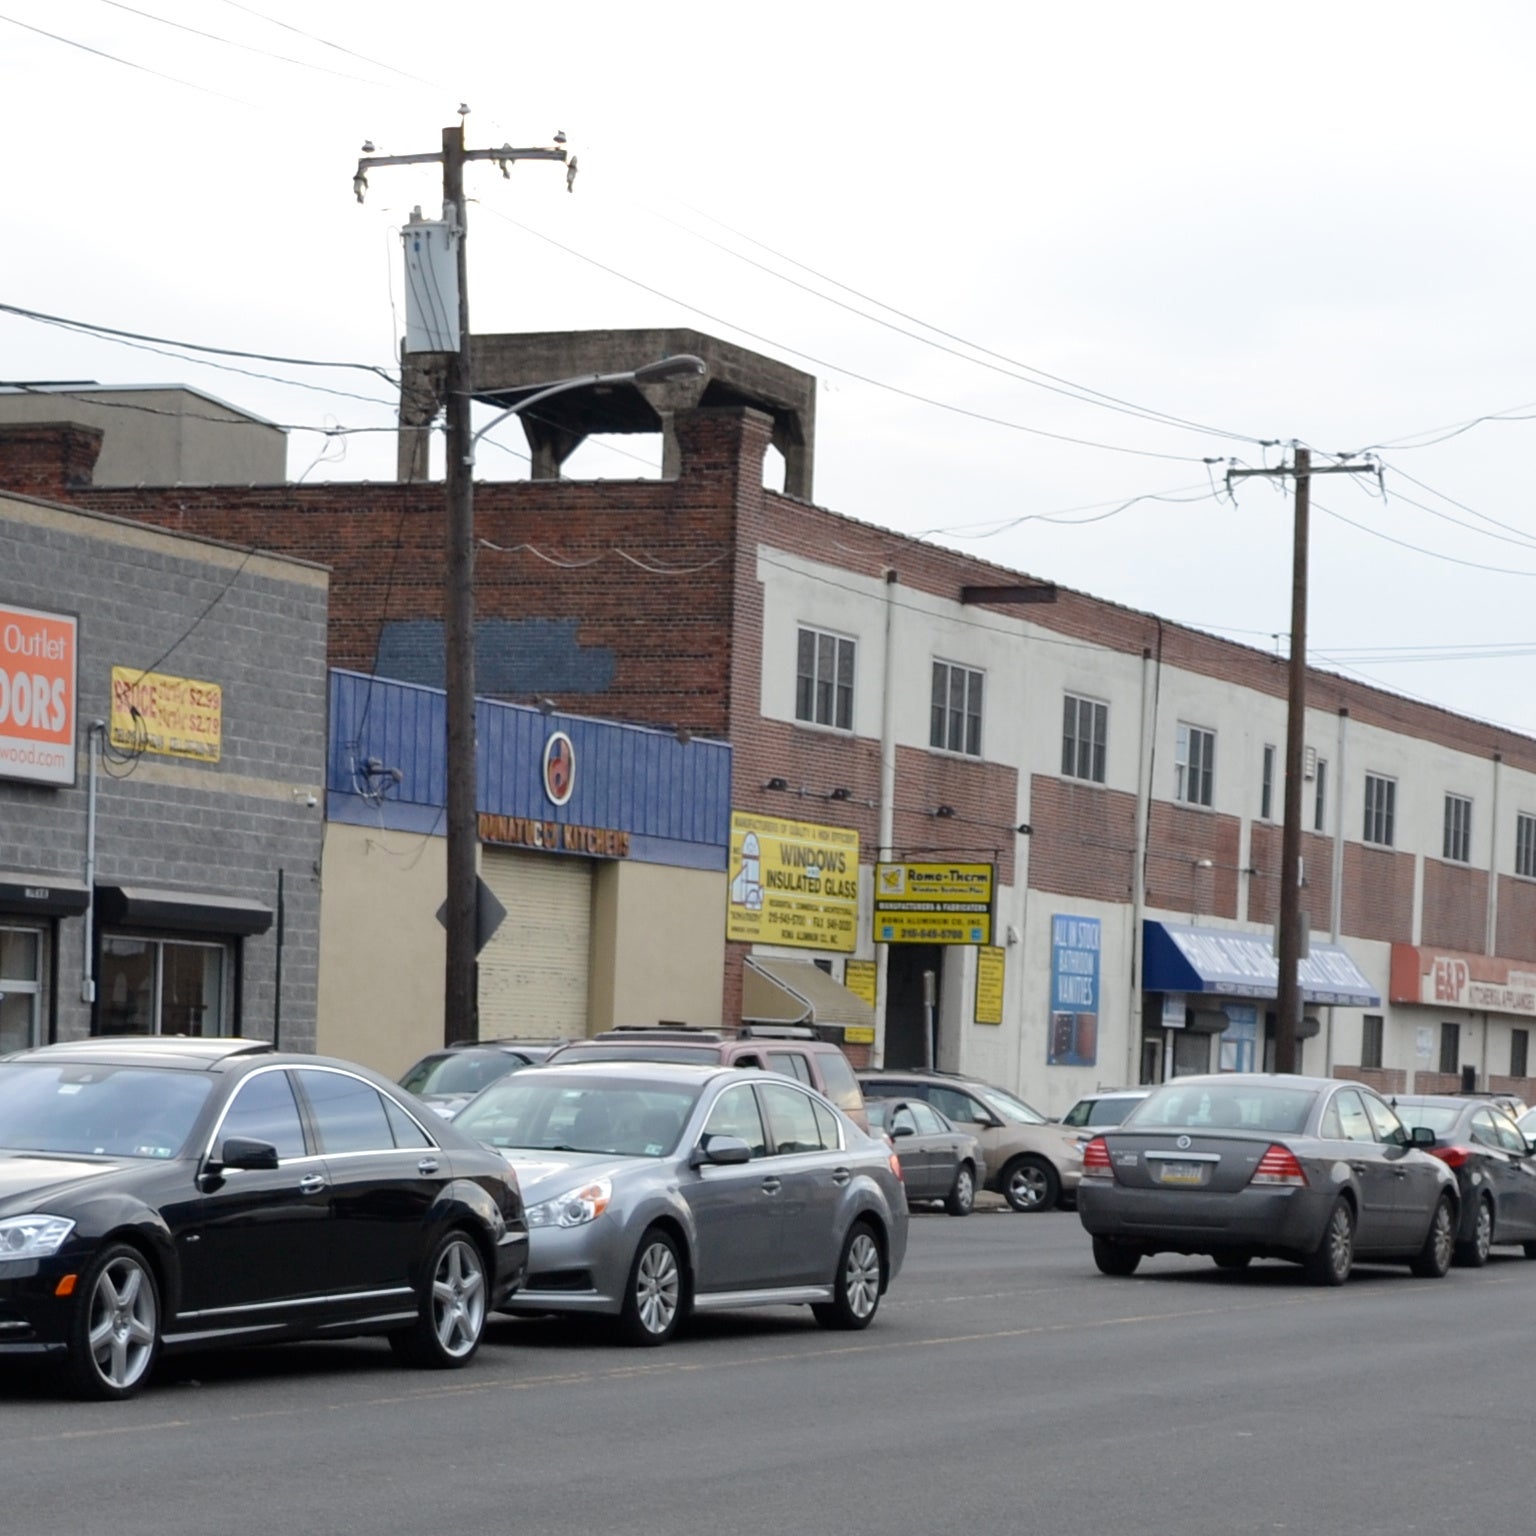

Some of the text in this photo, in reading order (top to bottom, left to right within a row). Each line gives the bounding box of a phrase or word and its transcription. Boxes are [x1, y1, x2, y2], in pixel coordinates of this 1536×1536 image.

[3, 623, 66, 661] Outlet
[779, 842, 847, 875] WINDOWS
[766, 868, 857, 900] INSULATED GLASS
[1054, 919, 1100, 950] ALL IN STOCK
[1434, 958, 1465, 1003] E&P
